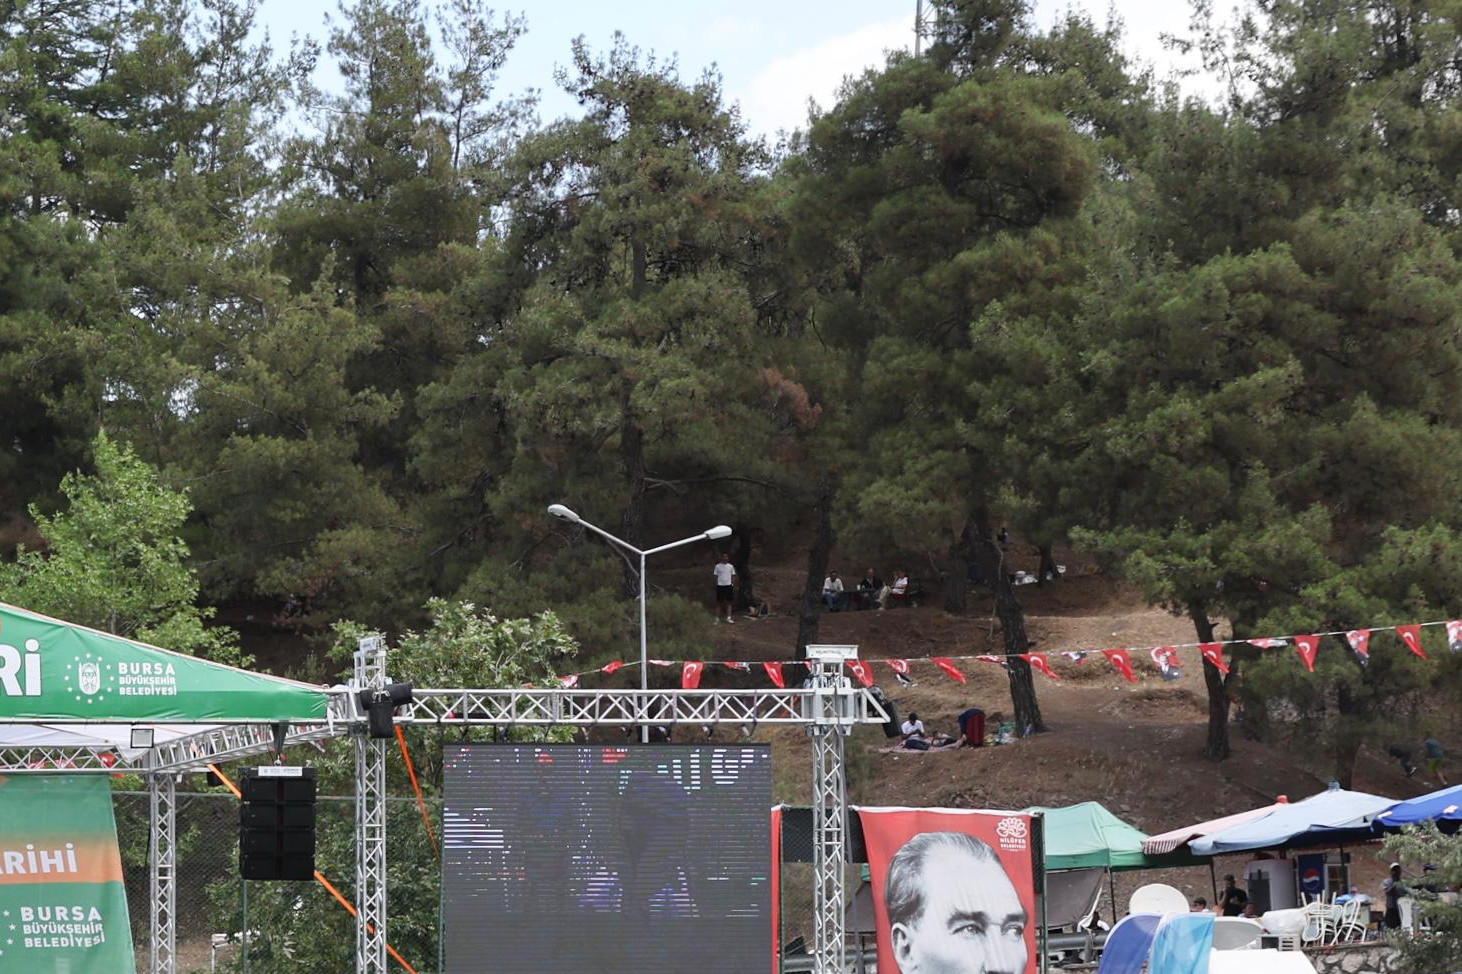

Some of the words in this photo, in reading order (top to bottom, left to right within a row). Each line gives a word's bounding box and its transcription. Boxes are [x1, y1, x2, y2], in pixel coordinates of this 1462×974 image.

[118, 662, 176, 675] BURSA
[119, 685, 177, 696] BELEDİYESİ
[20, 906, 103, 922] BURSA
[24, 932, 106, 949] BELEDİYESİ
